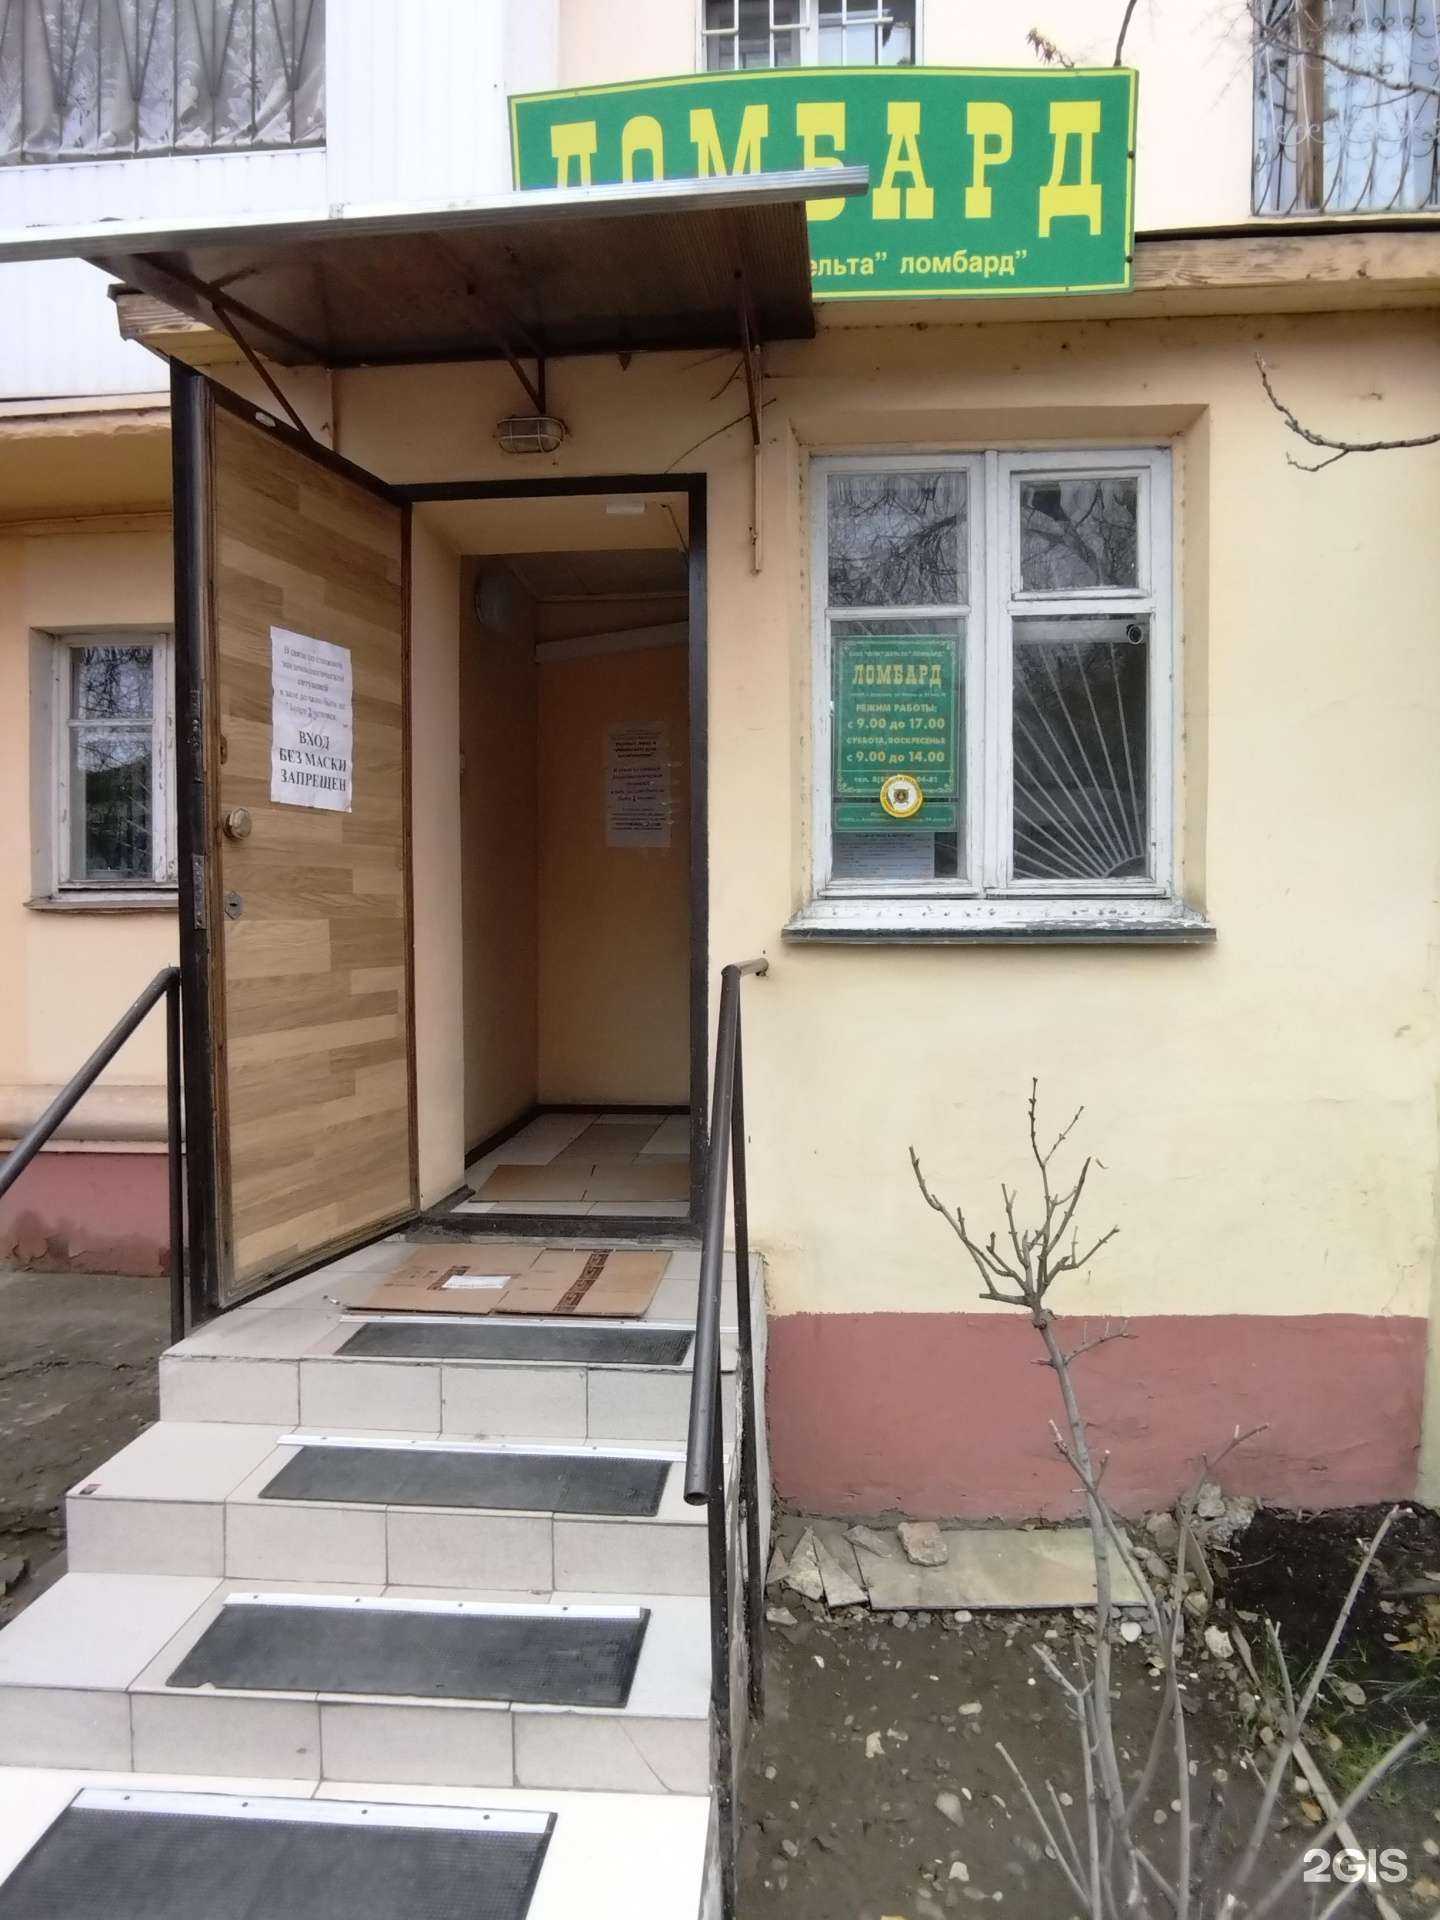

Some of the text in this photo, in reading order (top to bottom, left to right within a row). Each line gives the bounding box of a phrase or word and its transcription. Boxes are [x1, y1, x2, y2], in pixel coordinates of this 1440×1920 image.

[852, 664, 942, 688] ЛОМБАРД
[856, 718, 887, 729] 9.00
[889, 720, 906, 731] до
[909, 718, 945, 729] 17.00
[298, 730, 330, 751] ВХОД
[279, 747, 347, 773] БЕЗ МАСКИ
[856, 751, 886, 762] 9.00
[889, 754, 905, 764] до
[909, 751, 945, 762] 14.00
[280, 768, 347, 792] ЗАПРЕЩЕН
